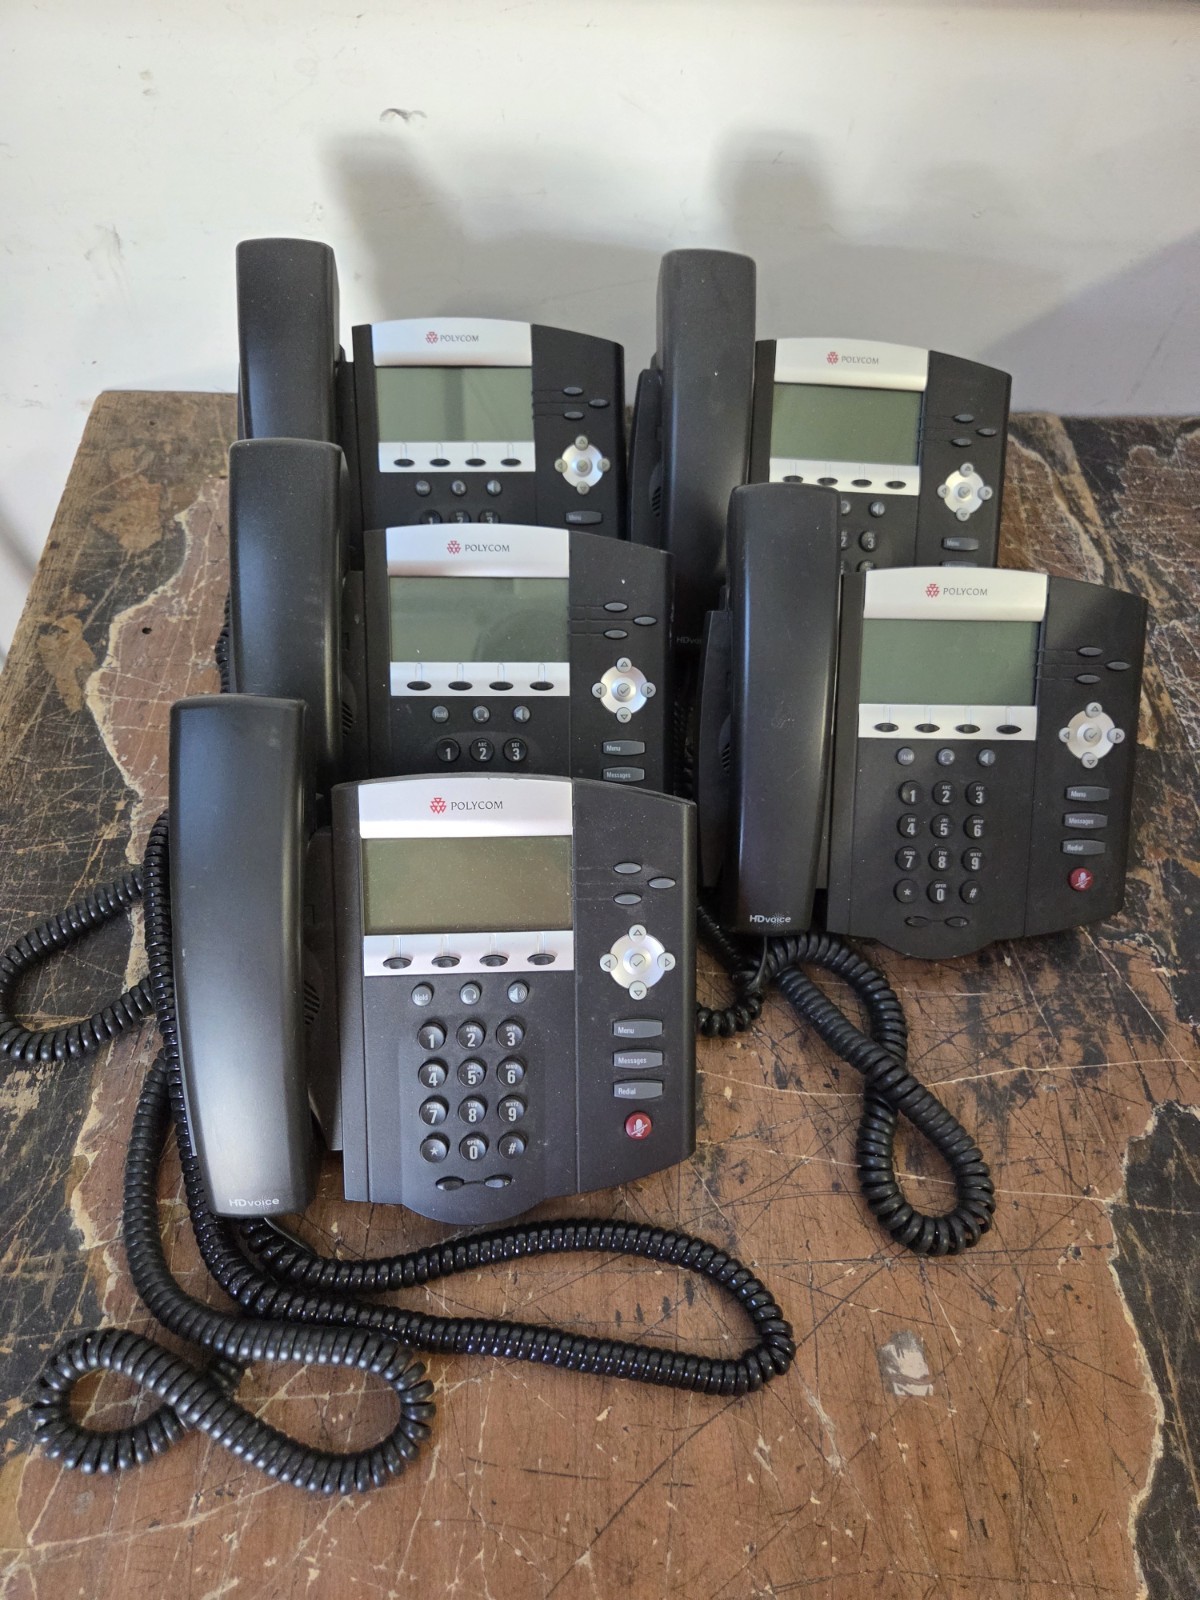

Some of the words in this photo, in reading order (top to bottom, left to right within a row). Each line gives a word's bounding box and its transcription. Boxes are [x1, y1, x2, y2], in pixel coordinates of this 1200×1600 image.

[440, 334, 479, 342] POLYCOM
[841, 356, 879, 365] POLYCOM
[465, 544, 510, 552] POLYCOM
[868, 538, 874, 549] 3
[943, 588, 988, 596] POLYCOM
[445, 748, 451, 760] 1
[479, 748, 487, 760] 2
[512, 748, 520, 760] 3
[910, 790, 916, 802] 1
[942, 790, 950, 803] 2
[976, 792, 983, 804] 3
[451, 801, 503, 810] POLYCOM
[907, 823, 915, 836] 4
[940, 824, 948, 836] 5
[974, 825, 982, 837] 6
[906, 856, 913, 868] 7
[938, 856, 946, 869] 8
[971, 858, 979, 870] 9
[936, 889, 944, 901] 0
[969, 888, 977, 898] #
[750, 914, 791, 923] HDvoice
[428, 1034, 435, 1048] 1
[467, 1033, 475, 1047] 2
[507, 1032, 515, 1046] 3
[618, 1056, 647, 1065] Messages
[428, 1073, 438, 1086] 4
[467, 1070, 476, 1085] 5
[507, 1070, 516, 1084] 6
[429, 1110, 437, 1124] 7
[468, 1108, 476, 1122] 8
[508, 1108, 516, 1122] 9
[470, 1146, 478, 1159] 0
[508, 1143, 516, 1154] #
[229, 1198, 280, 1207] HDvoice
